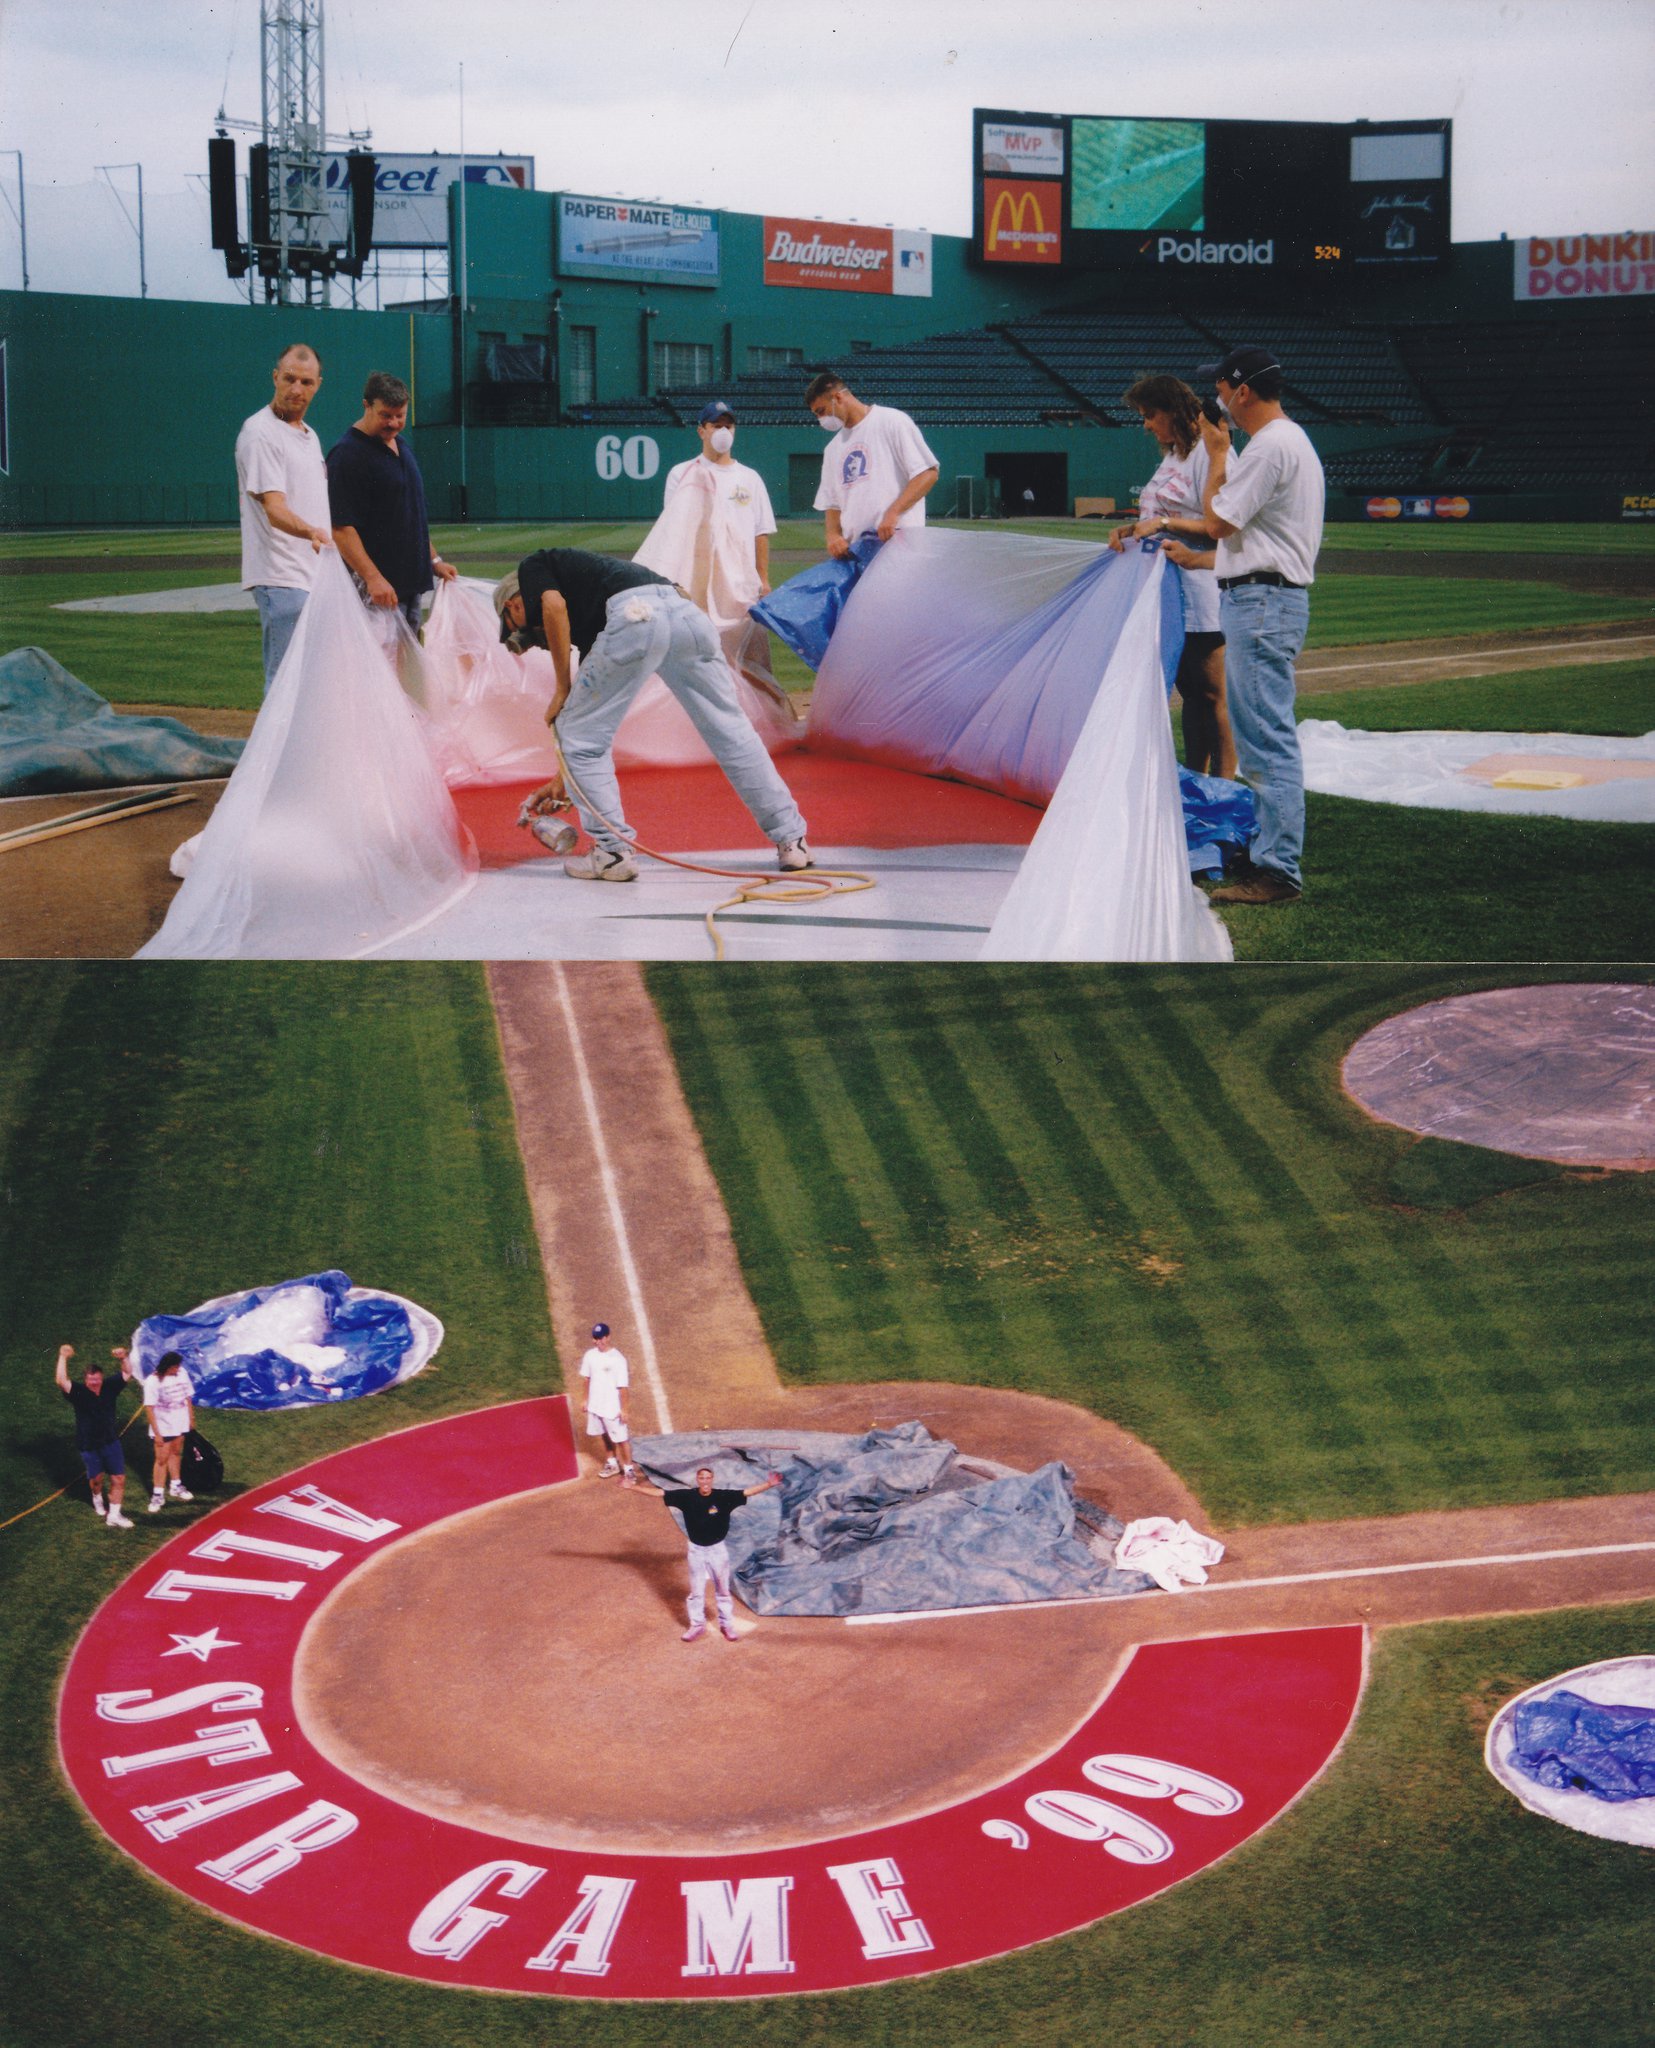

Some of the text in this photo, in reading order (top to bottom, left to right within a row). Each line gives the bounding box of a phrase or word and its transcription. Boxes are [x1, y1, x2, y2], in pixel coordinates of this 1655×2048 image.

[1005, 135, 1042, 151] MVP
[564, 202, 671, 227] PAPER MATE
[768, 230, 888, 271] Budweiser
[1157, 236, 1274, 265] Polaroid
[1528, 233, 1655, 267] DUNKI
[595, 434, 660, 480] 60
[96, 1483, 1243, 1977] ALL STAR GAME '99
